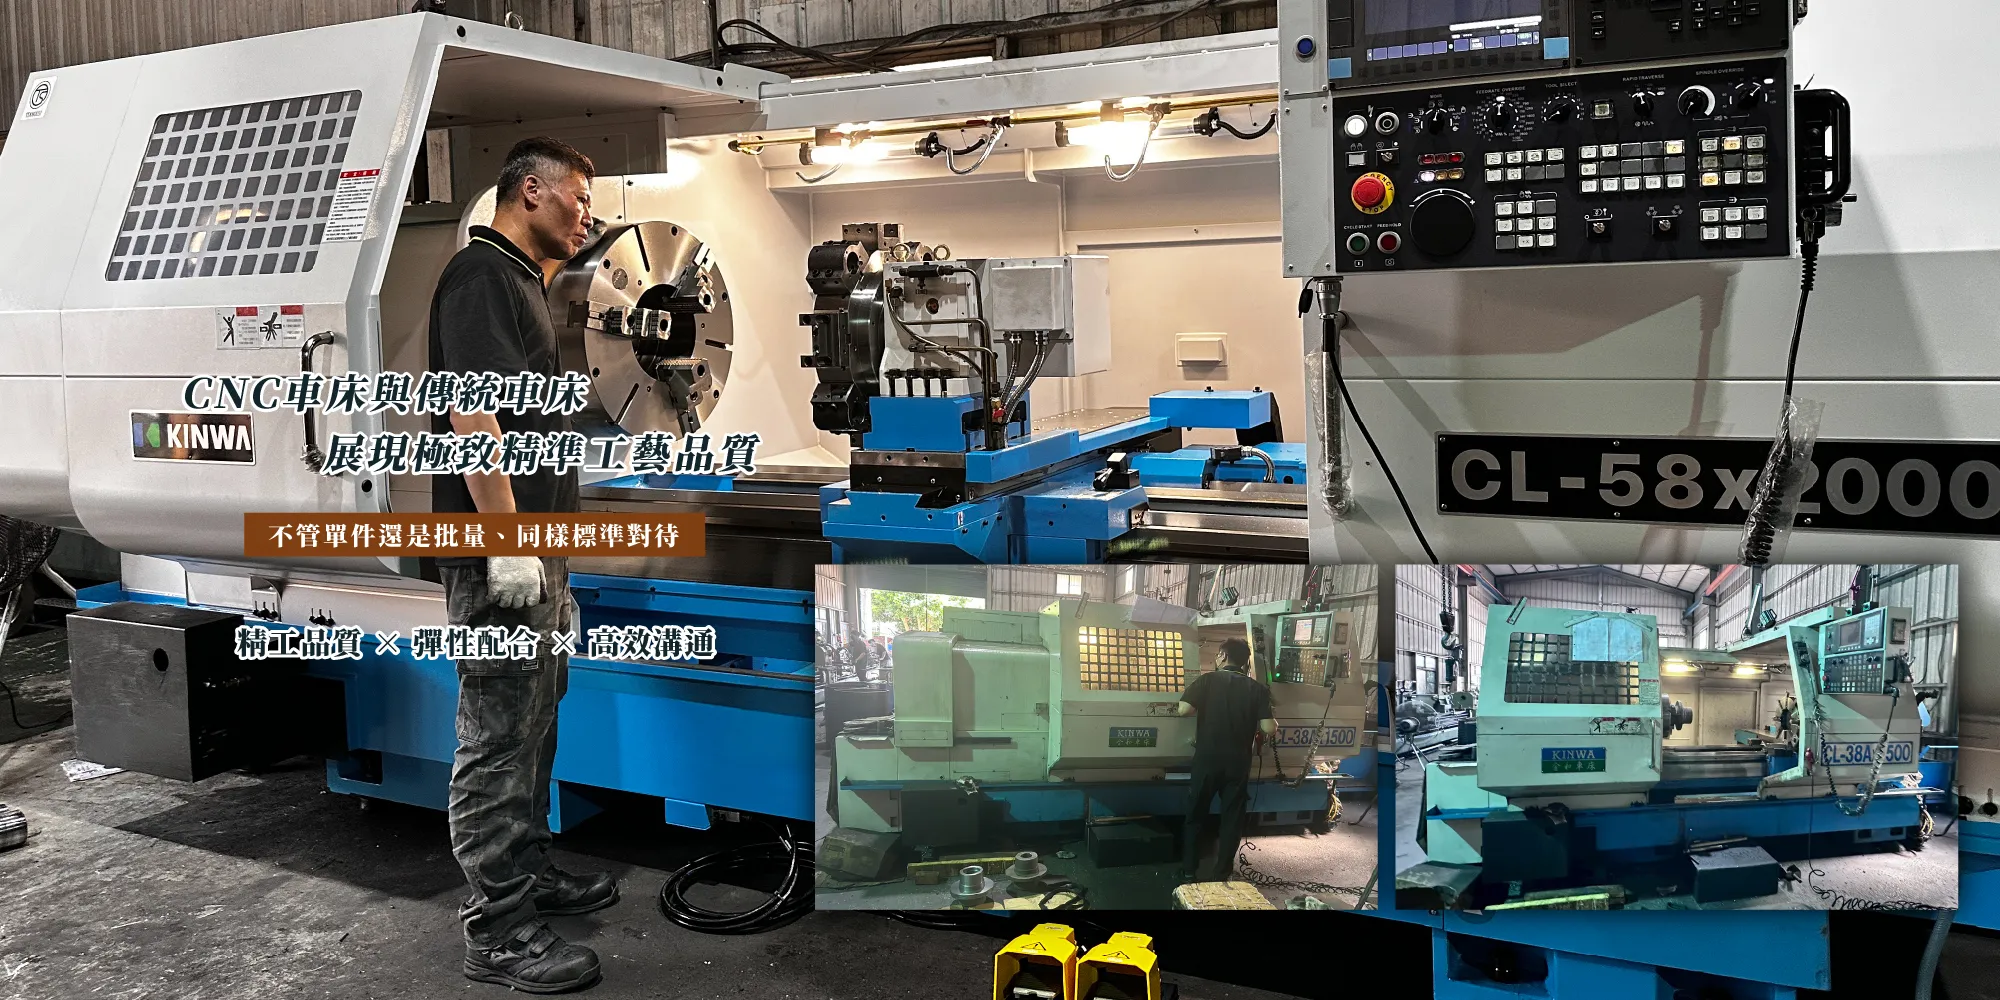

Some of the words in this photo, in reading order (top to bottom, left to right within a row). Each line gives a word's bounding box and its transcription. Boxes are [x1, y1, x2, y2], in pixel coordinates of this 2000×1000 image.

[166, 423, 252, 451] KINWA
[1117, 729, 1150, 738] KINWA
[1552, 749, 1596, 760] KINWA
